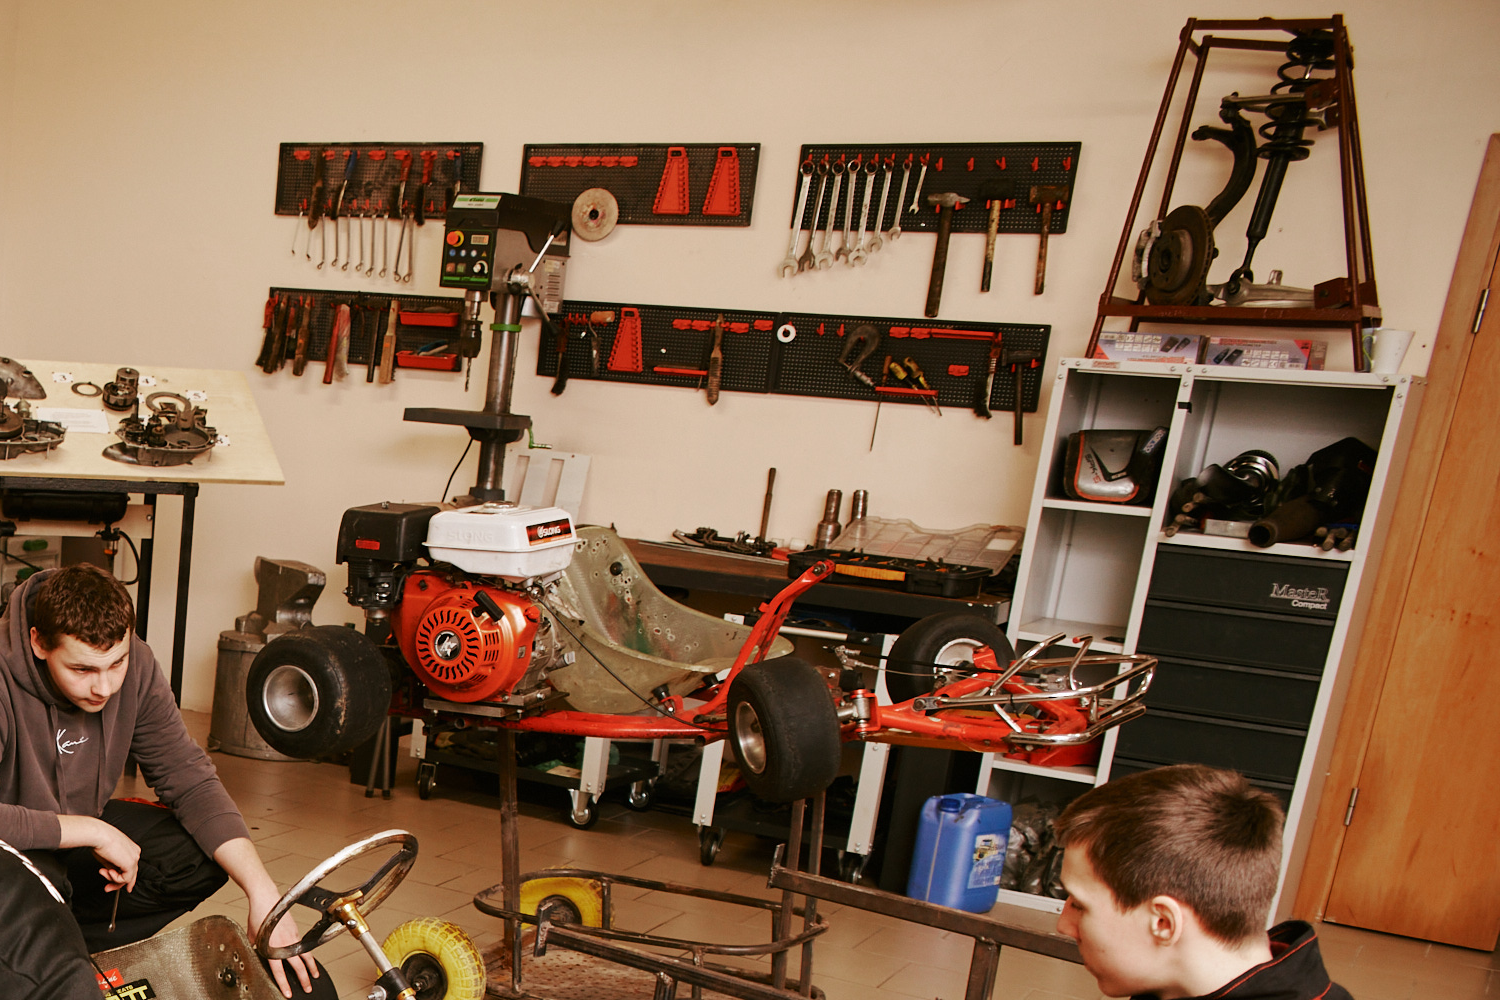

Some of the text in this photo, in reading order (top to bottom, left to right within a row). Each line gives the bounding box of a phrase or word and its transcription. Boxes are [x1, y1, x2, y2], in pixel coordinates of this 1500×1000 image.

[542, 525, 562, 537] SLONG
[1291, 600, 1328, 610] Compact
[116, 984, 134, 994] EATS
